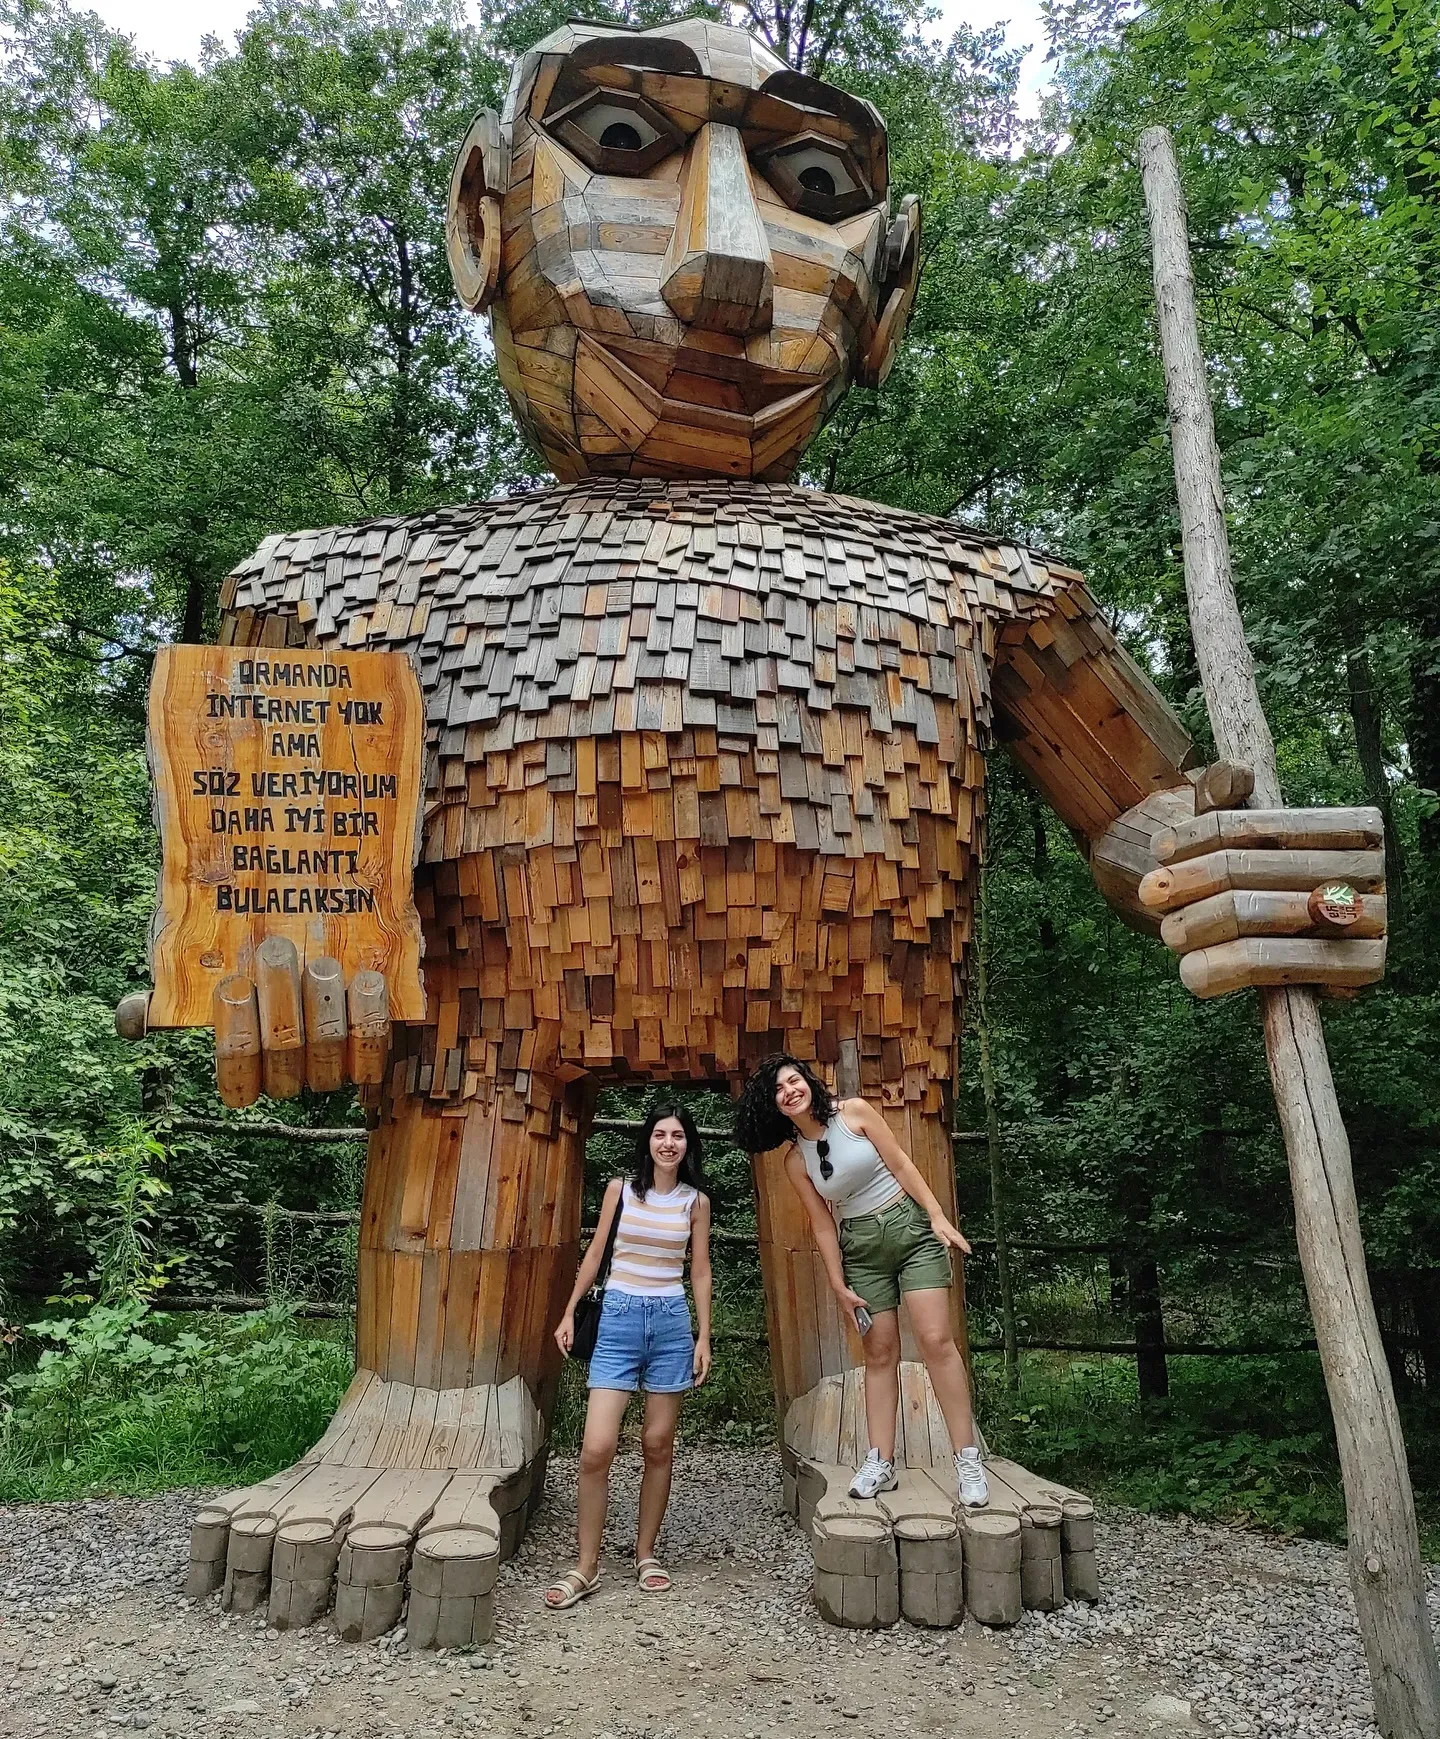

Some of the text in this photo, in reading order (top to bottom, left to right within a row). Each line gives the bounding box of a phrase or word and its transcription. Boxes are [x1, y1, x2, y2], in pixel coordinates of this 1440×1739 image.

[239, 660, 352, 688] ORMANDA
[206, 689, 384, 725] İNTERNET YOK
[272, 733, 321, 758] AMA
[193, 766, 396, 799] SÖZ VERİYORUM
[211, 803, 379, 836] DAHA İYİ BİR
[233, 844, 358, 875] BAĞLANTI
[217, 886, 373, 914] BULACAKSIN
